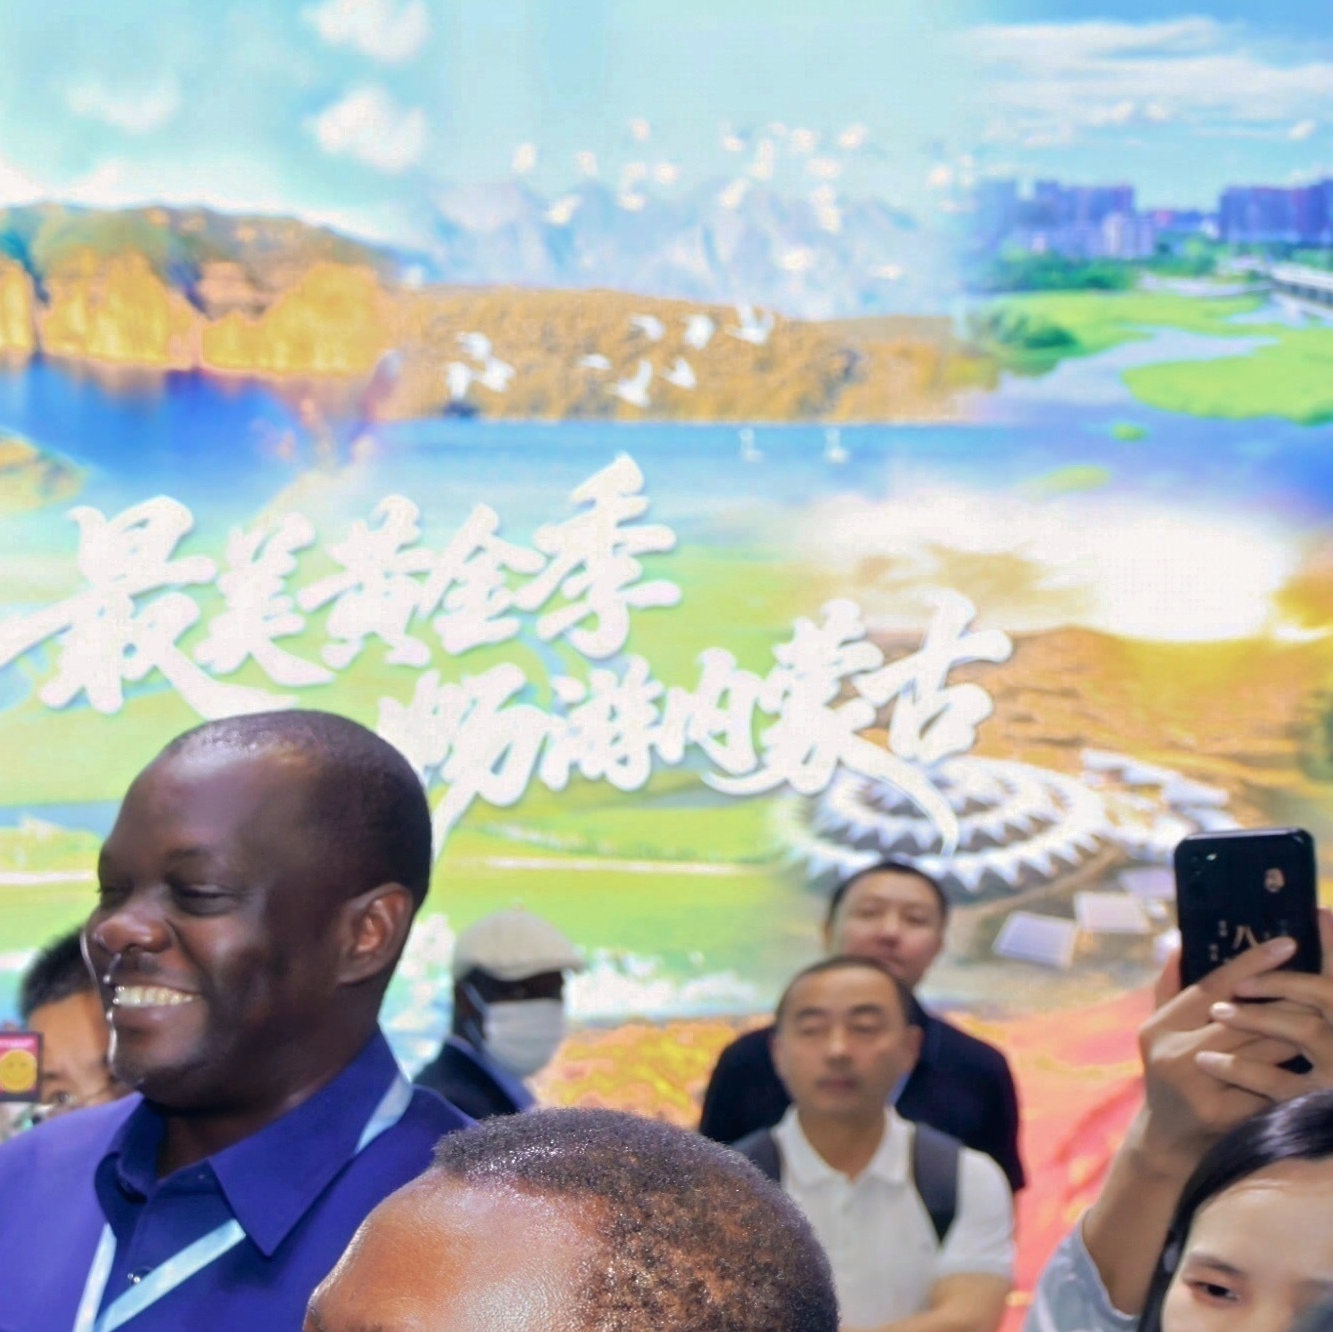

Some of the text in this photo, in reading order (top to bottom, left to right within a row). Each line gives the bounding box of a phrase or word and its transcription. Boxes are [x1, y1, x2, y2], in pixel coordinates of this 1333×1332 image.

[378, 586, 1014, 860] 畅游内蒙古
